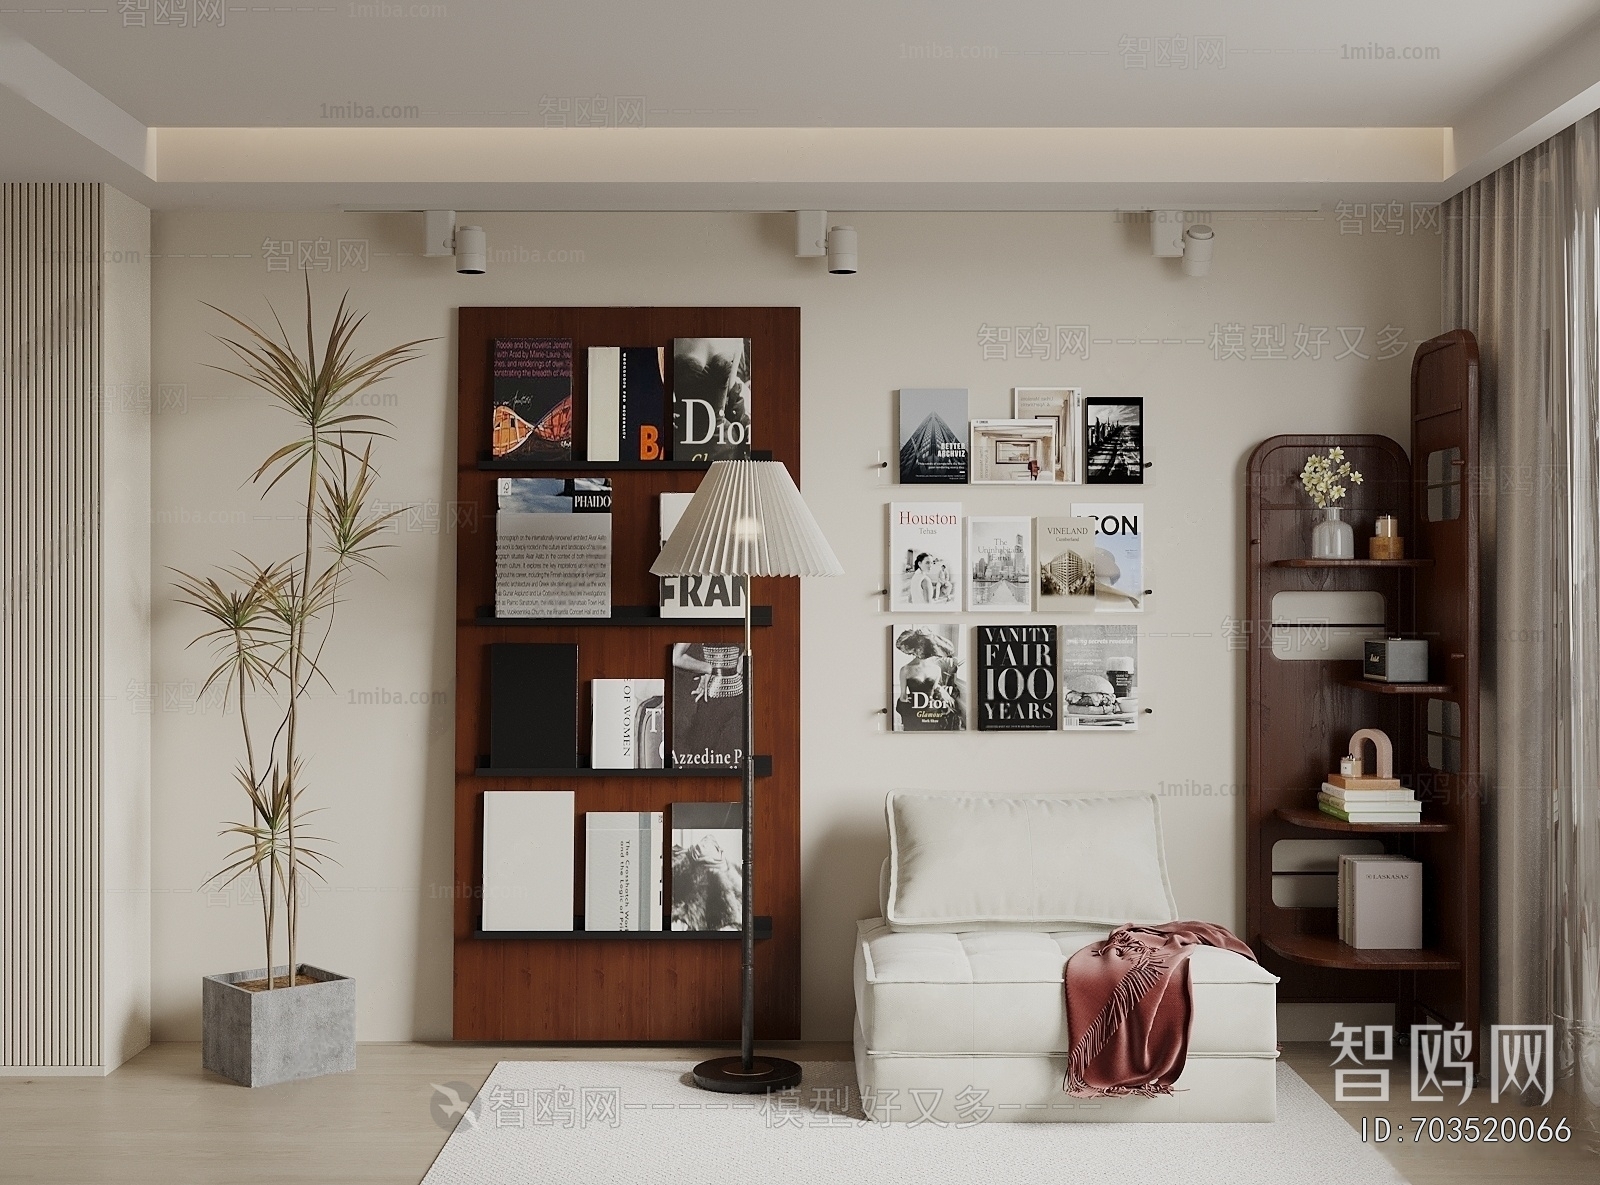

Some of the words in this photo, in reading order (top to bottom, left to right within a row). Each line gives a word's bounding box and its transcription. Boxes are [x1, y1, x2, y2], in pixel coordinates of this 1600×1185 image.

[937, 450, 966, 458] ARCHVIZ
[899, 511, 957, 525] Houston
[1077, 515, 1138, 536] ON
[1047, 527, 1089, 535] VINELAND
[994, 538, 1008, 546] The
[985, 627, 1052, 643] VANITY
[1109, 637, 1134, 645] revealed
[984, 644, 1052, 666] FAIR
[984, 667, 1055, 701] 100
[911, 691, 948, 709] Dior
[984, 702, 1054, 720] YEARS
[623, 705, 631, 757] WOMEN
[619, 906, 625, 914] of
